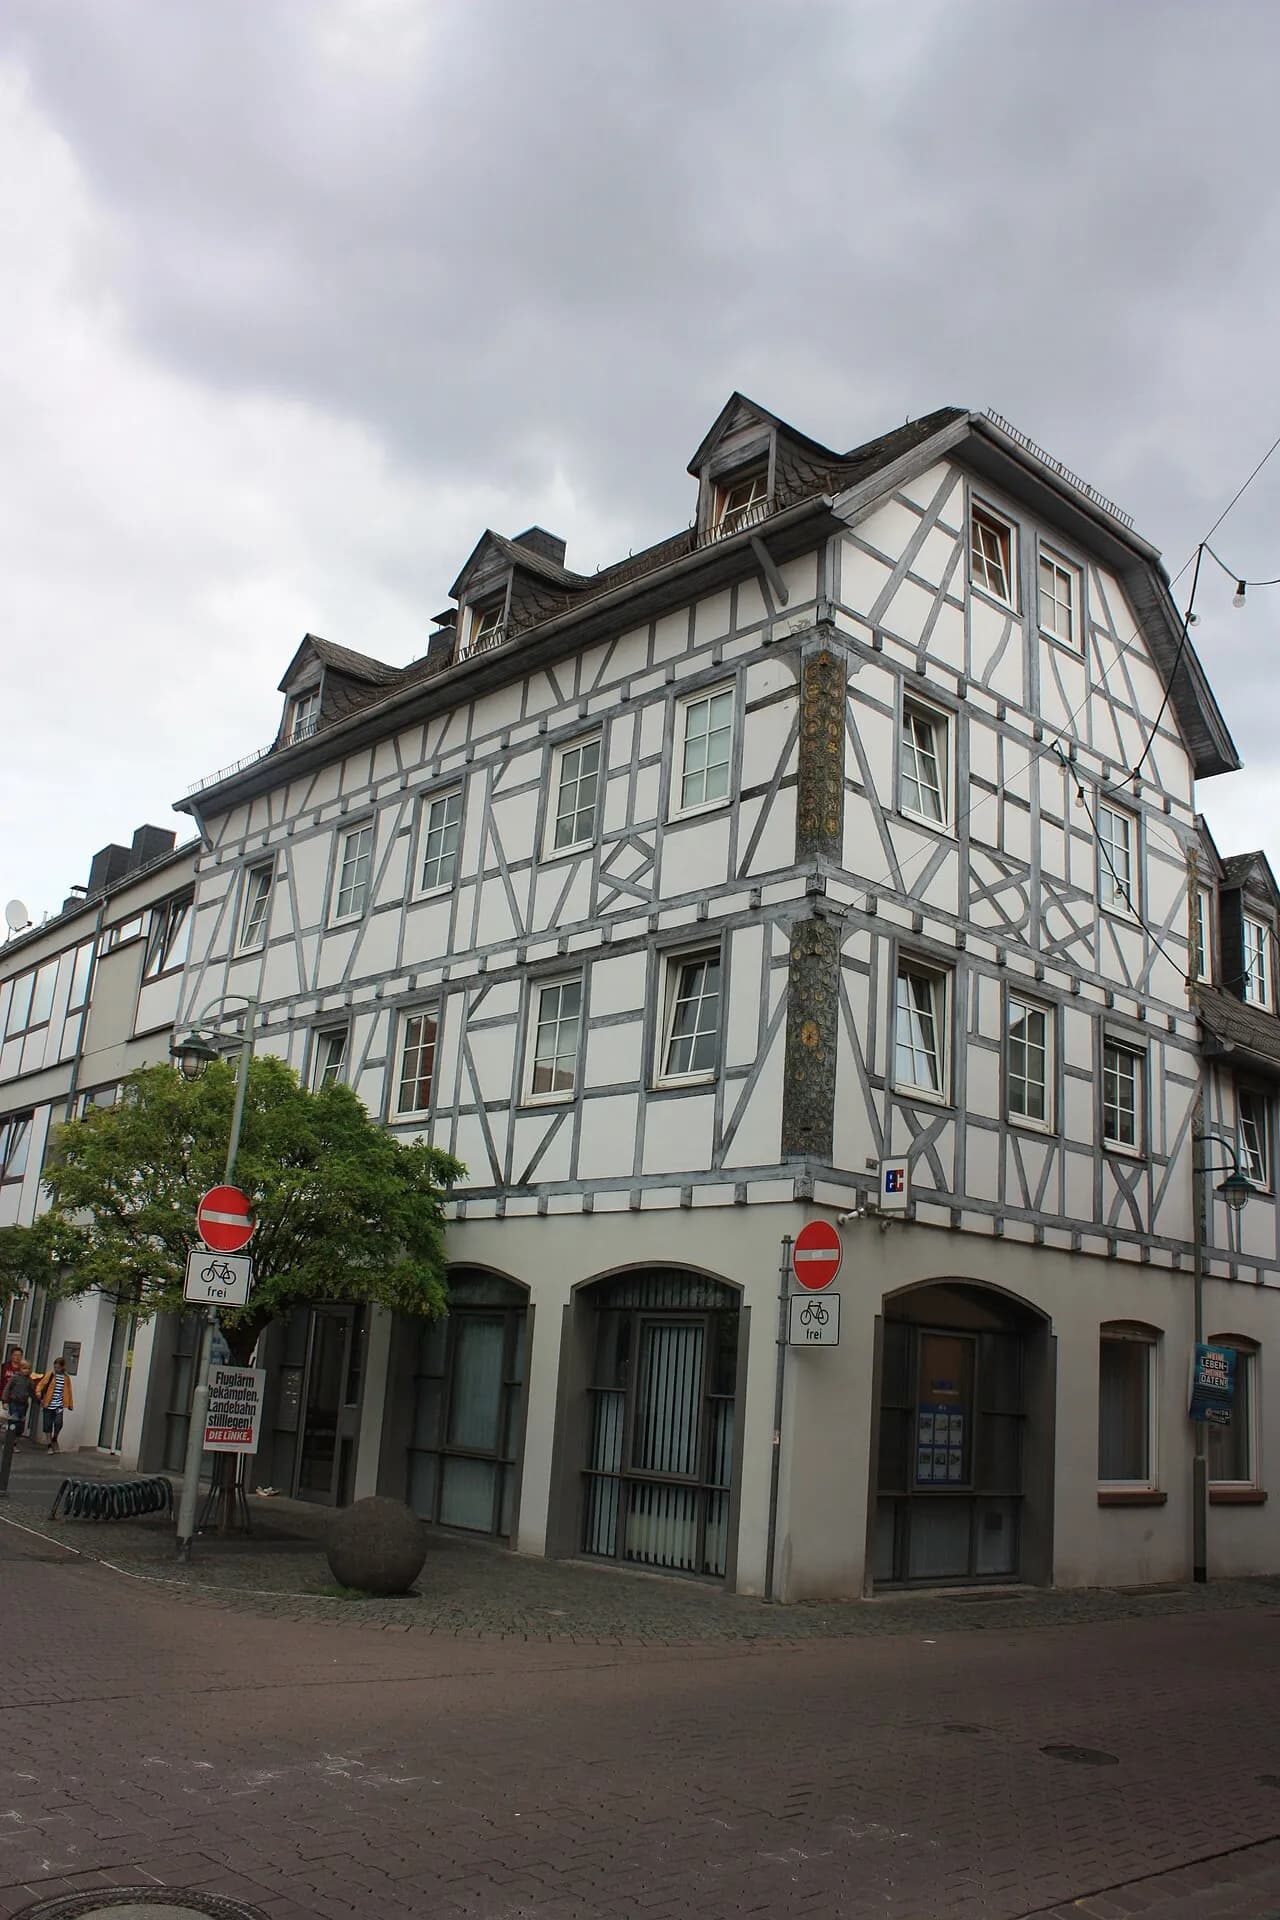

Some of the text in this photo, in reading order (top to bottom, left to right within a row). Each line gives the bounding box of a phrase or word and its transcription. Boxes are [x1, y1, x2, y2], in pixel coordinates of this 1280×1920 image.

[207, 1286, 227, 1299] frei
[806, 1327, 822, 1340] frei
[216, 1371, 255, 1388] Fluglärm
[208, 1385, 259, 1403] bekämpfen.
[208, 1400, 257, 1416] Landebahn
[208, 1414, 253, 1430] stilllegen!
[208, 1430, 223, 1441] DIE
